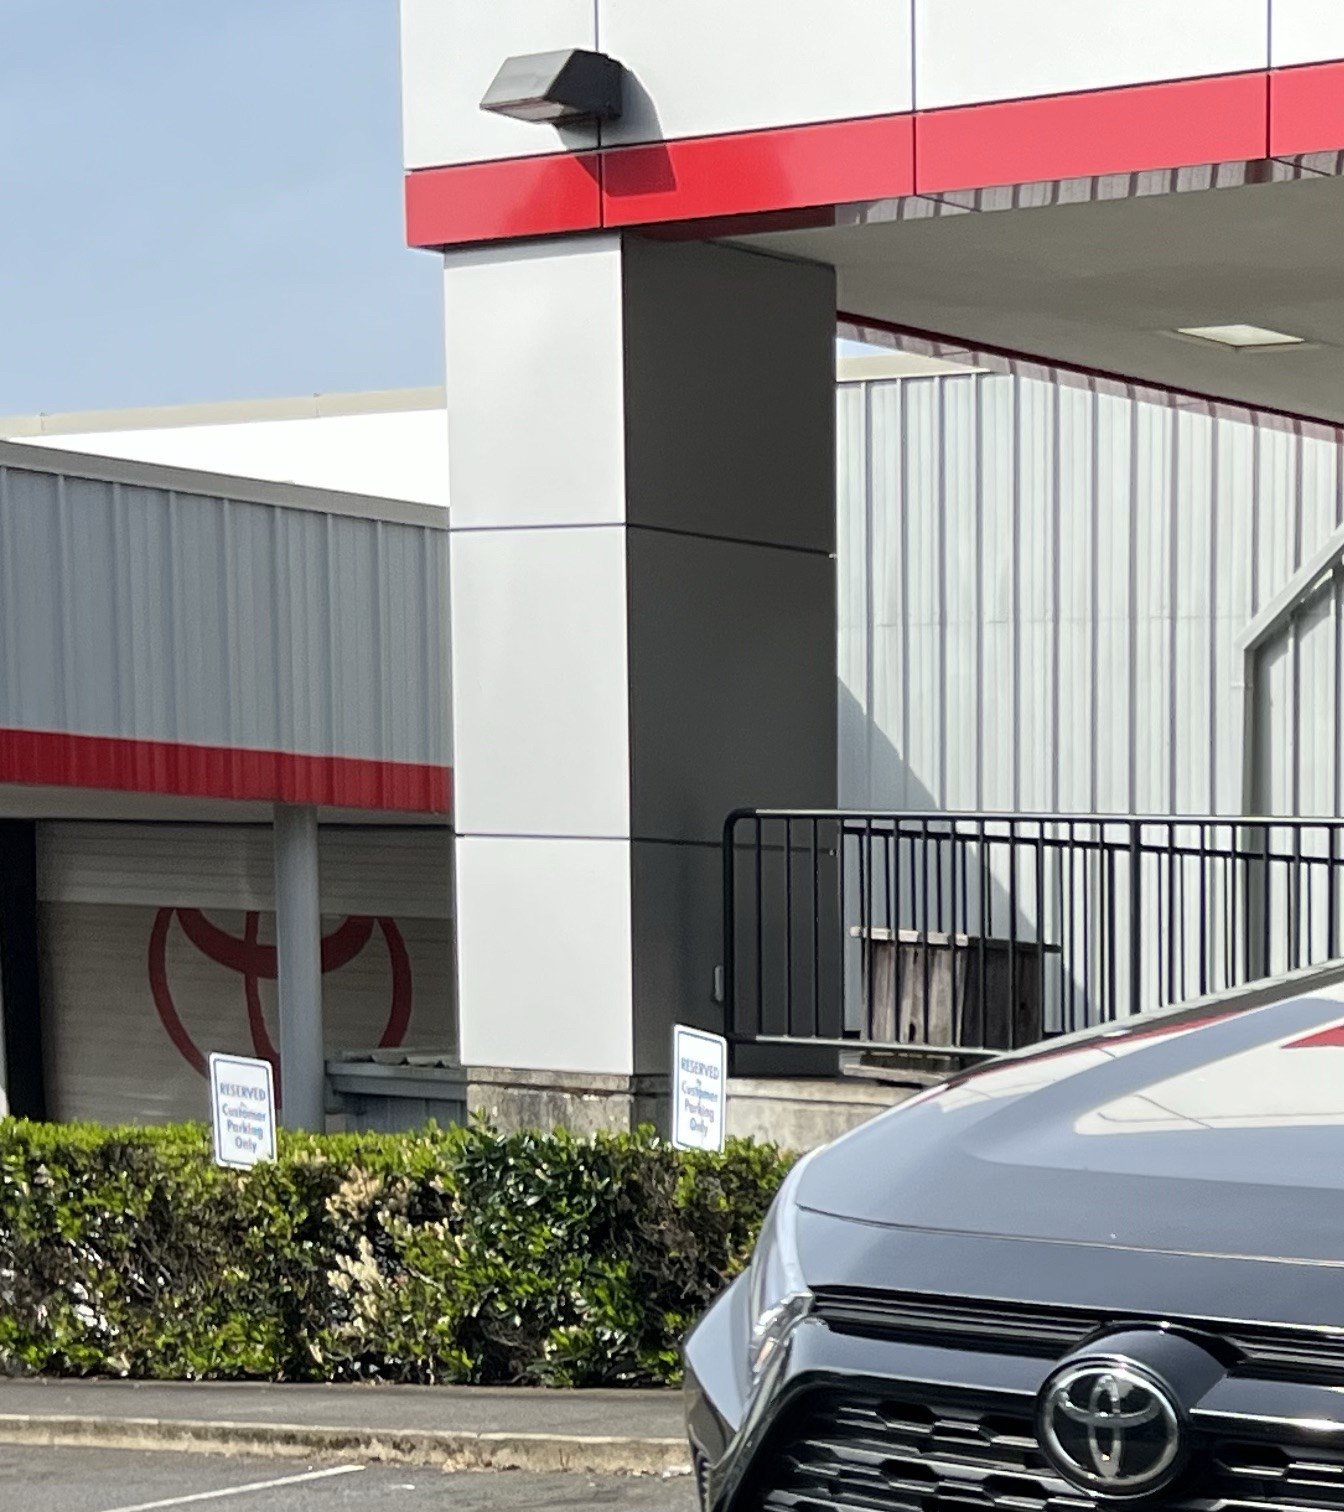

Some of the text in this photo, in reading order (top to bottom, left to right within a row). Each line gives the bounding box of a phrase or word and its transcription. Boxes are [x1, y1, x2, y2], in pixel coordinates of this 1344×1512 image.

[681, 1057, 720, 1080] RESERVED
[220, 1082, 266, 1101] RESERVED
[222, 1103, 267, 1121] Customer
[226, 1118, 263, 1140] Parking
[235, 1135, 257, 1153] Only
